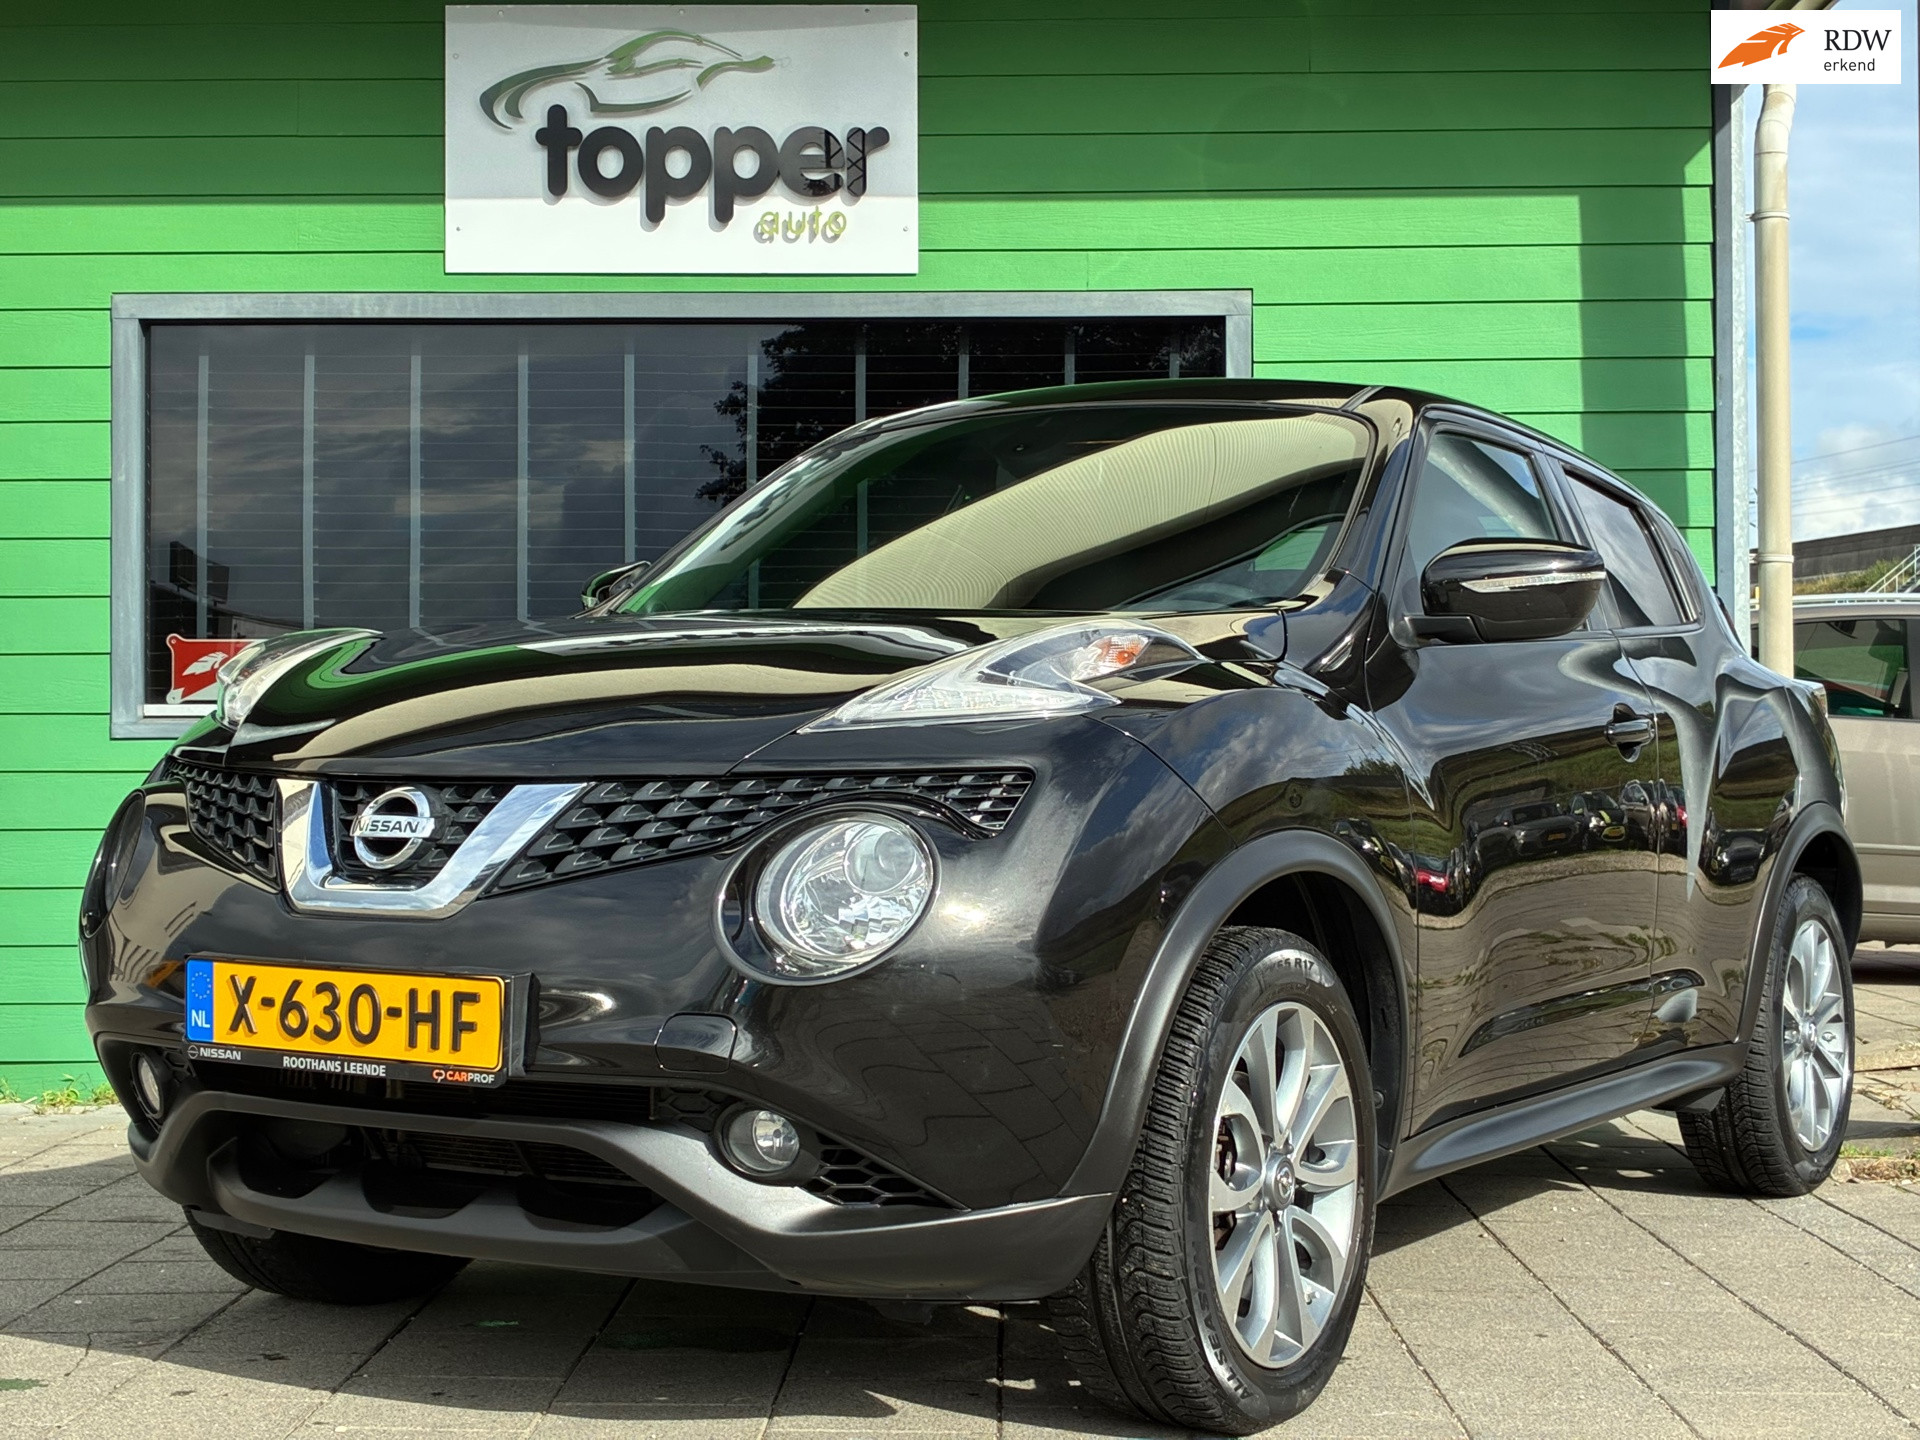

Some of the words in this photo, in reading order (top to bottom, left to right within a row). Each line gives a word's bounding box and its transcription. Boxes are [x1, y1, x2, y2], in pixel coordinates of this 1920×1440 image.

[535, 104, 890, 223] topper
[760, 205, 847, 235] auto
[354, 820, 419, 833] NISSAN
[191, 1009, 210, 1029] NL
[229, 974, 481, 1052] X-630-HF
[200, 1047, 242, 1061] NISSAN
[283, 1056, 342, 1073] ROOTHANS
[344, 1061, 386, 1077] LEENDE
[446, 1070, 495, 1084] CARPROF
